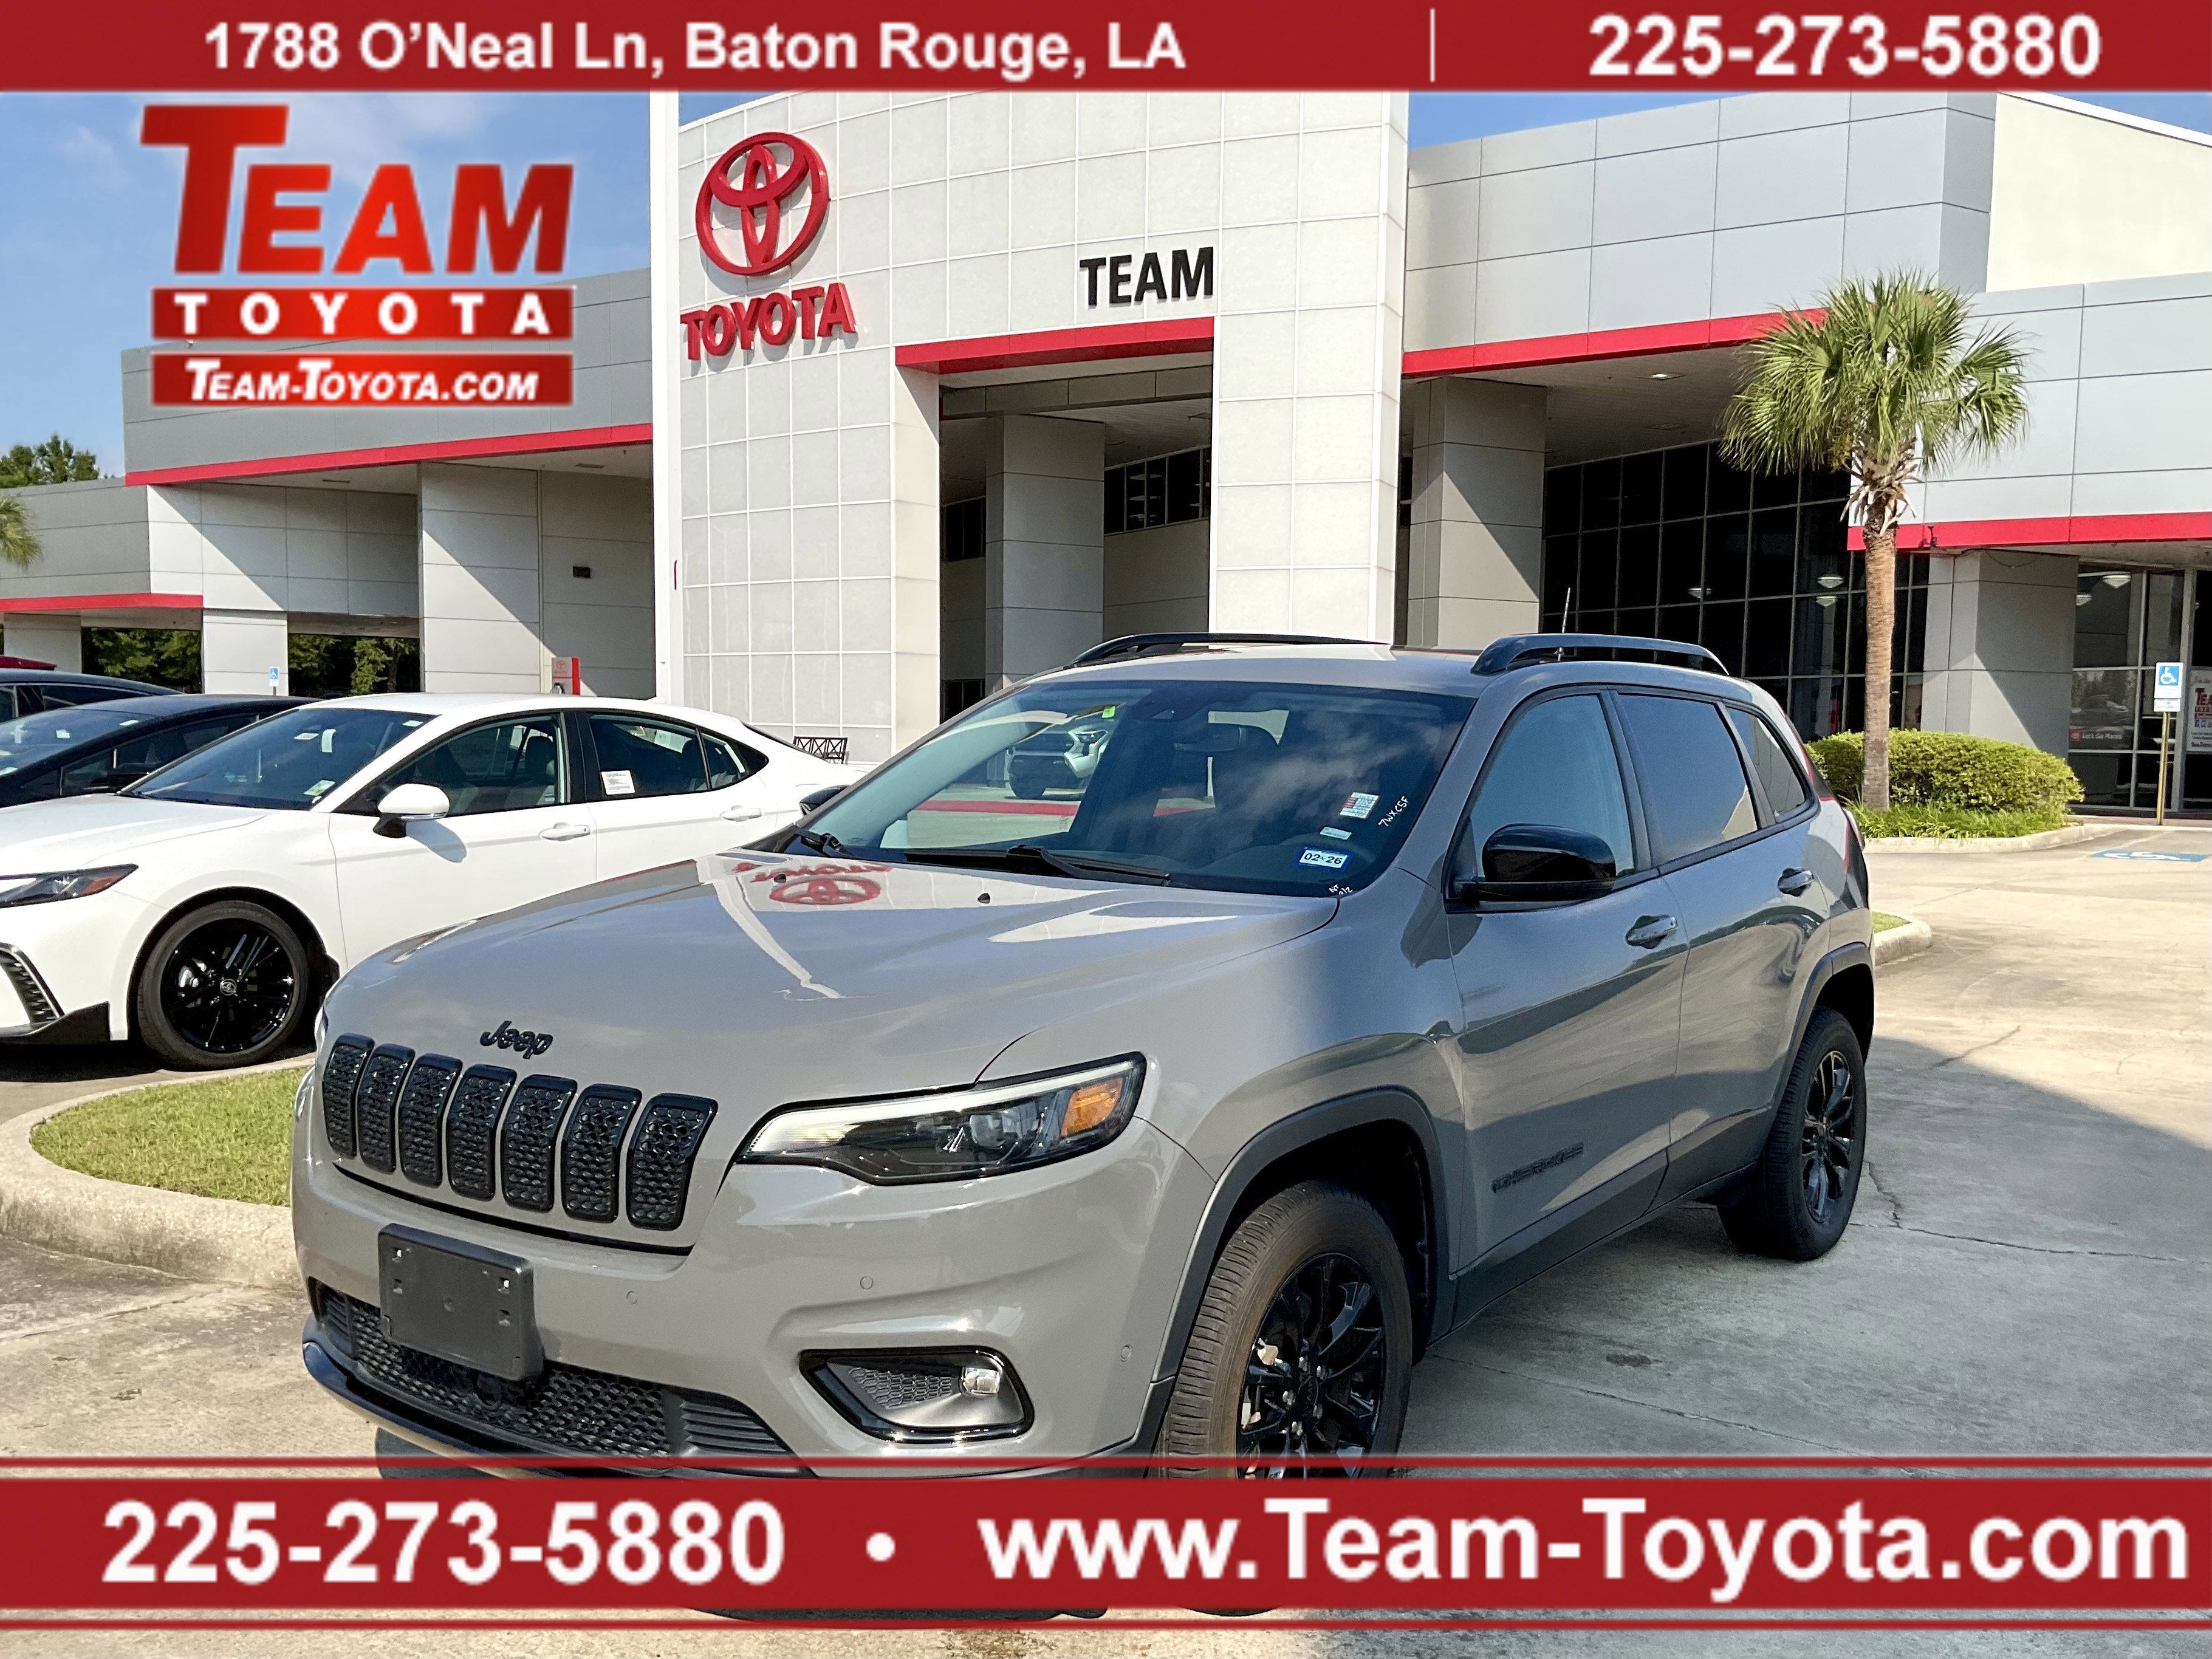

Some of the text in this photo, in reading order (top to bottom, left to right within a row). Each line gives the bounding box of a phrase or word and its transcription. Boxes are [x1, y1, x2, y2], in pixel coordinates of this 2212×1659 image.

[1080, 247, 1214, 306] TEAM
[680, 282, 857, 360] TOYOTA
[480, 1020, 553, 1059] Jeep
